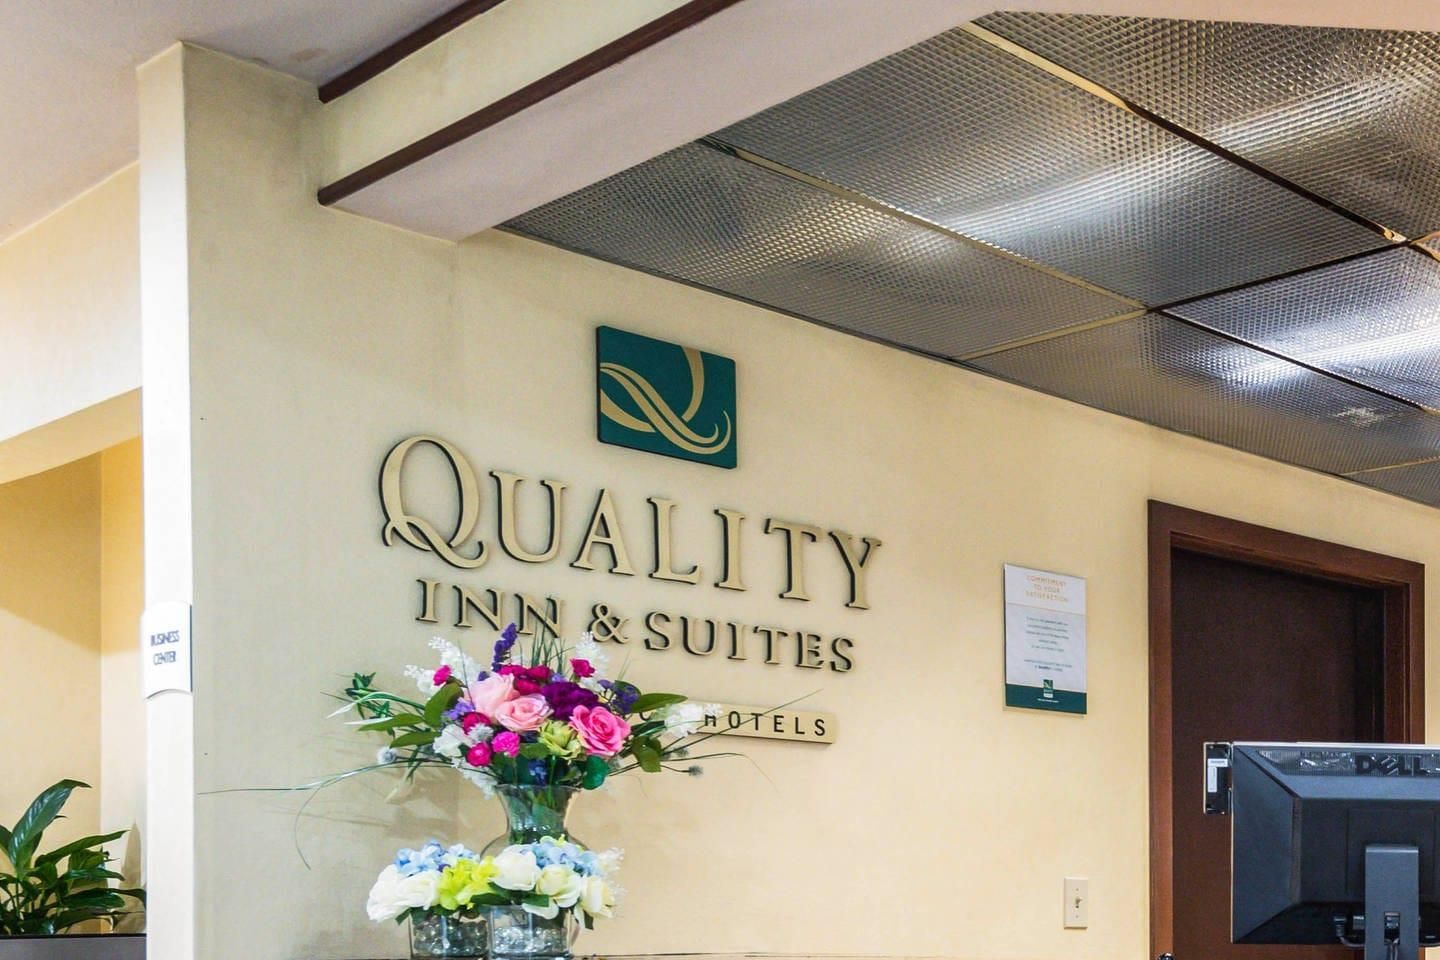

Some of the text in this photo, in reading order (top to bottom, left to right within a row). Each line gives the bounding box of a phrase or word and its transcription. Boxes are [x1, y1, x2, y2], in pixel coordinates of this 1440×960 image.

[378, 434, 882, 611] QUALITY
[415, 578, 856, 673] INN & SUITES
[704, 711, 826, 736] HOTELS
